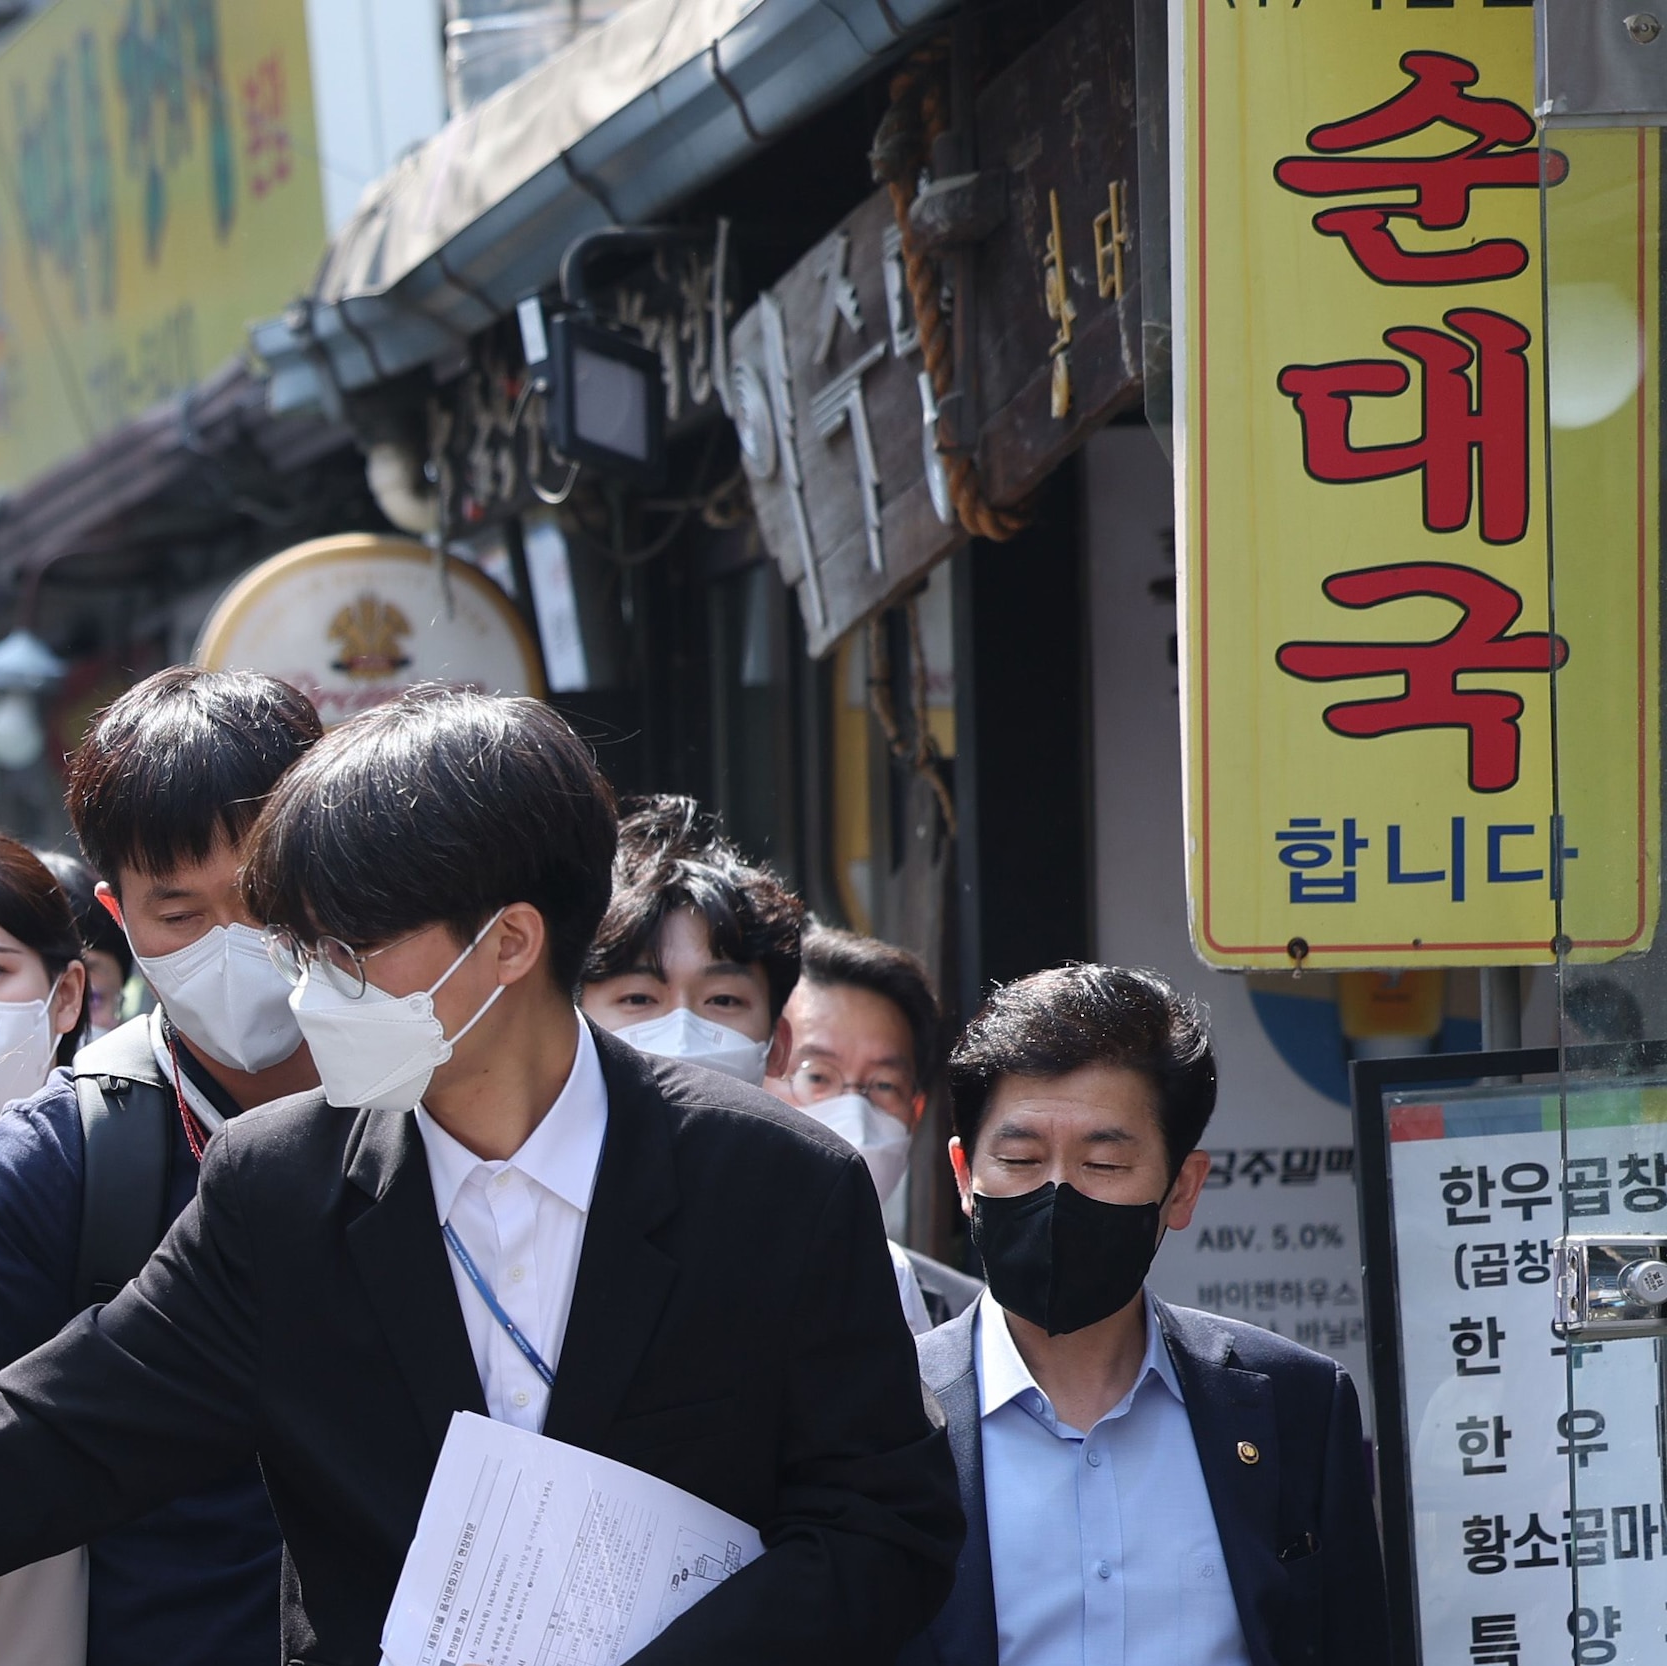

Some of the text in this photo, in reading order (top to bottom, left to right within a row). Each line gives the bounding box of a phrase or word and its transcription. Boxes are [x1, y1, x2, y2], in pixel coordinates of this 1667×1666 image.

[1273, 51, 1569, 793] 순대국
[1275, 816, 1578, 903] 합니다
[1439, 1153, 1667, 1226] 한우곱창
[1272, 1223, 1344, 1250] 5.0%
